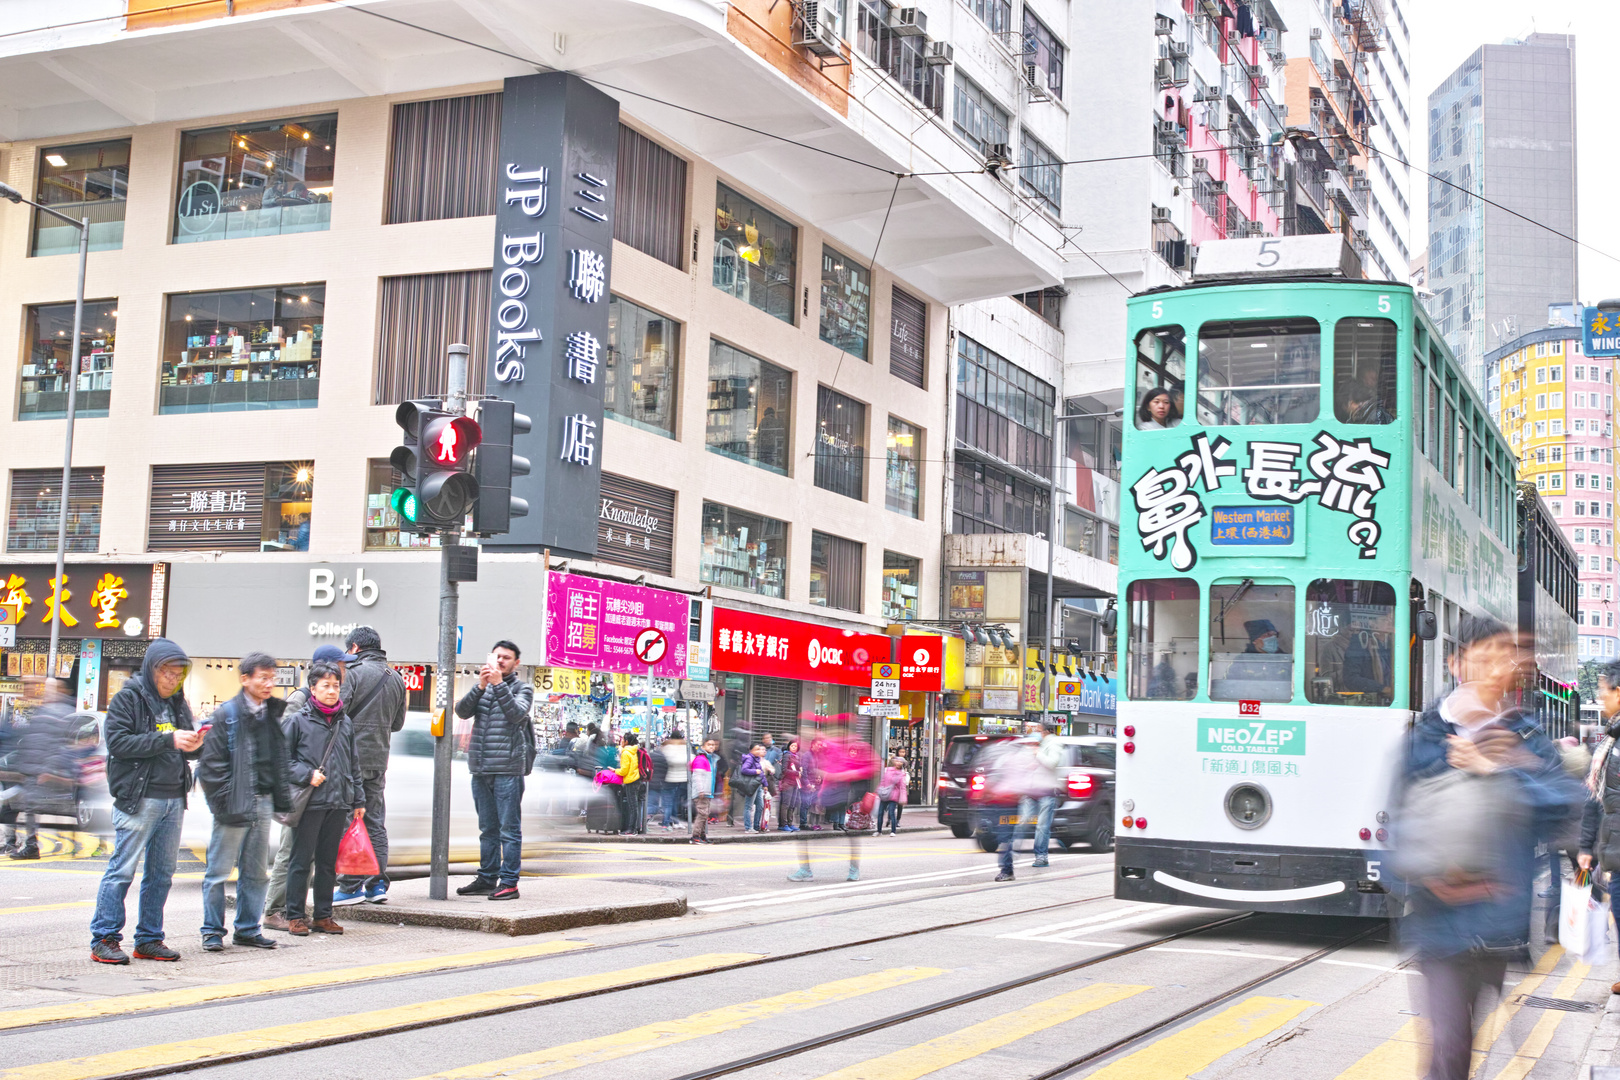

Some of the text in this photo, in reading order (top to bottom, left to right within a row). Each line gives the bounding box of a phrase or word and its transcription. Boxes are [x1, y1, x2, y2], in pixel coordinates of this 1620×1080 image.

[1255, 240, 1282, 268] 5
[494, 163, 549, 384] JP Books
[1151, 301, 1164, 319] 5
[1377, 295, 1392, 313] 5
[560, 172, 609, 466] 三聯書店
[1591, 312, 1620, 336] 永
[893, 319, 909, 343] Life
[169, 489, 248, 513] 三聯書店
[599, 498, 659, 534] Knowledge
[1213, 510, 1291, 523] Western Market
[308, 568, 379, 607] B+b
[569, 592, 598, 621] 檔主
[567, 621, 597, 650] 招募
[718, 628, 790, 661] 華僑永亨銀行
[821, 646, 843, 666] OCBC
[534, 674, 553, 690] $5
[558, 675, 570, 690] $5
[575, 675, 587, 693] $5
[876, 689, 894, 697] 全日
[1241, 702, 1260, 713] 032
[1220, 744, 1280, 753] COLD TABLET
[1366, 860, 1381, 881] 5
